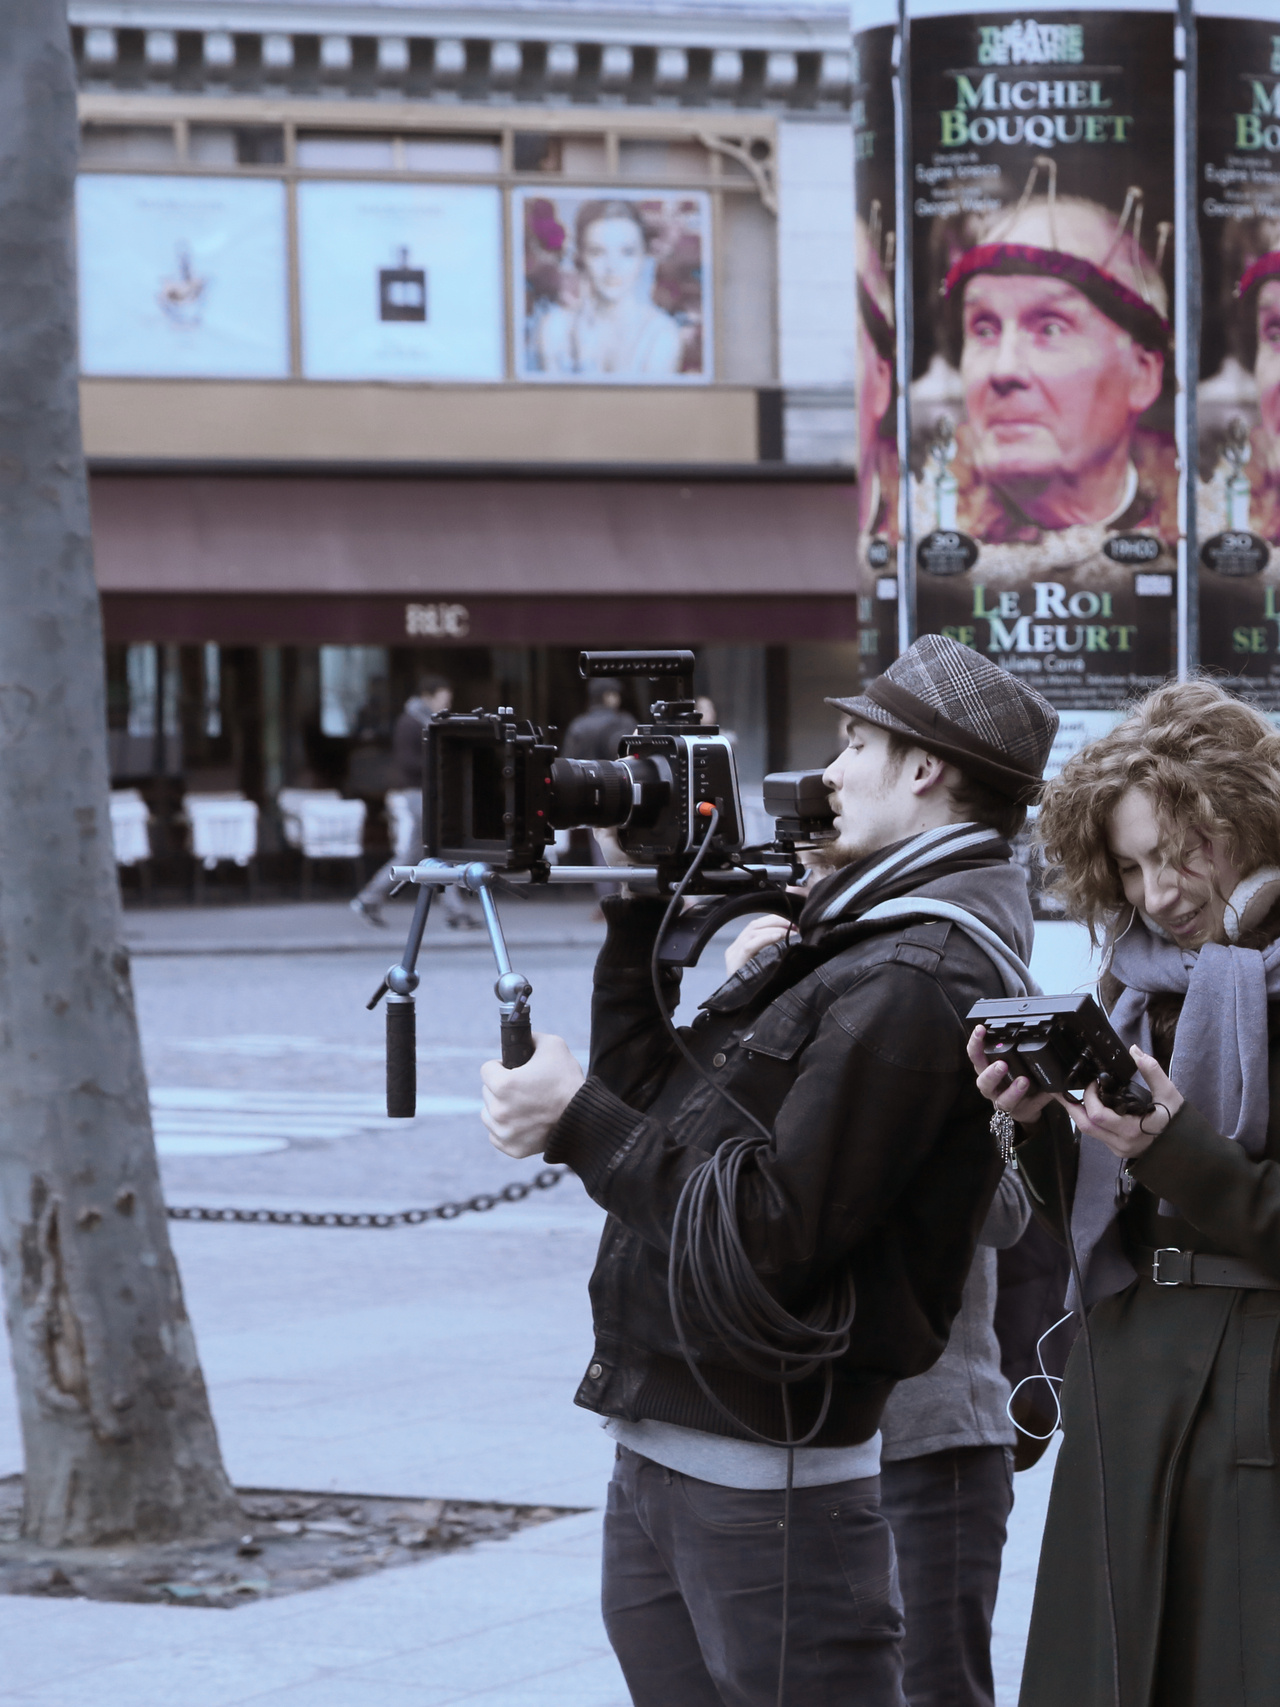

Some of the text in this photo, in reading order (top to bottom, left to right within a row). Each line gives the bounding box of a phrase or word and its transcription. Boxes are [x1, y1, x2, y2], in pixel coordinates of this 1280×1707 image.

[955, 72, 1113, 111] MICHEL
[940, 110, 1134, 149] BOUQUET
[973, 581, 1113, 619] LE ROI
[987, 615, 1137, 652] MEURT
[1233, 626, 1268, 653] SE
